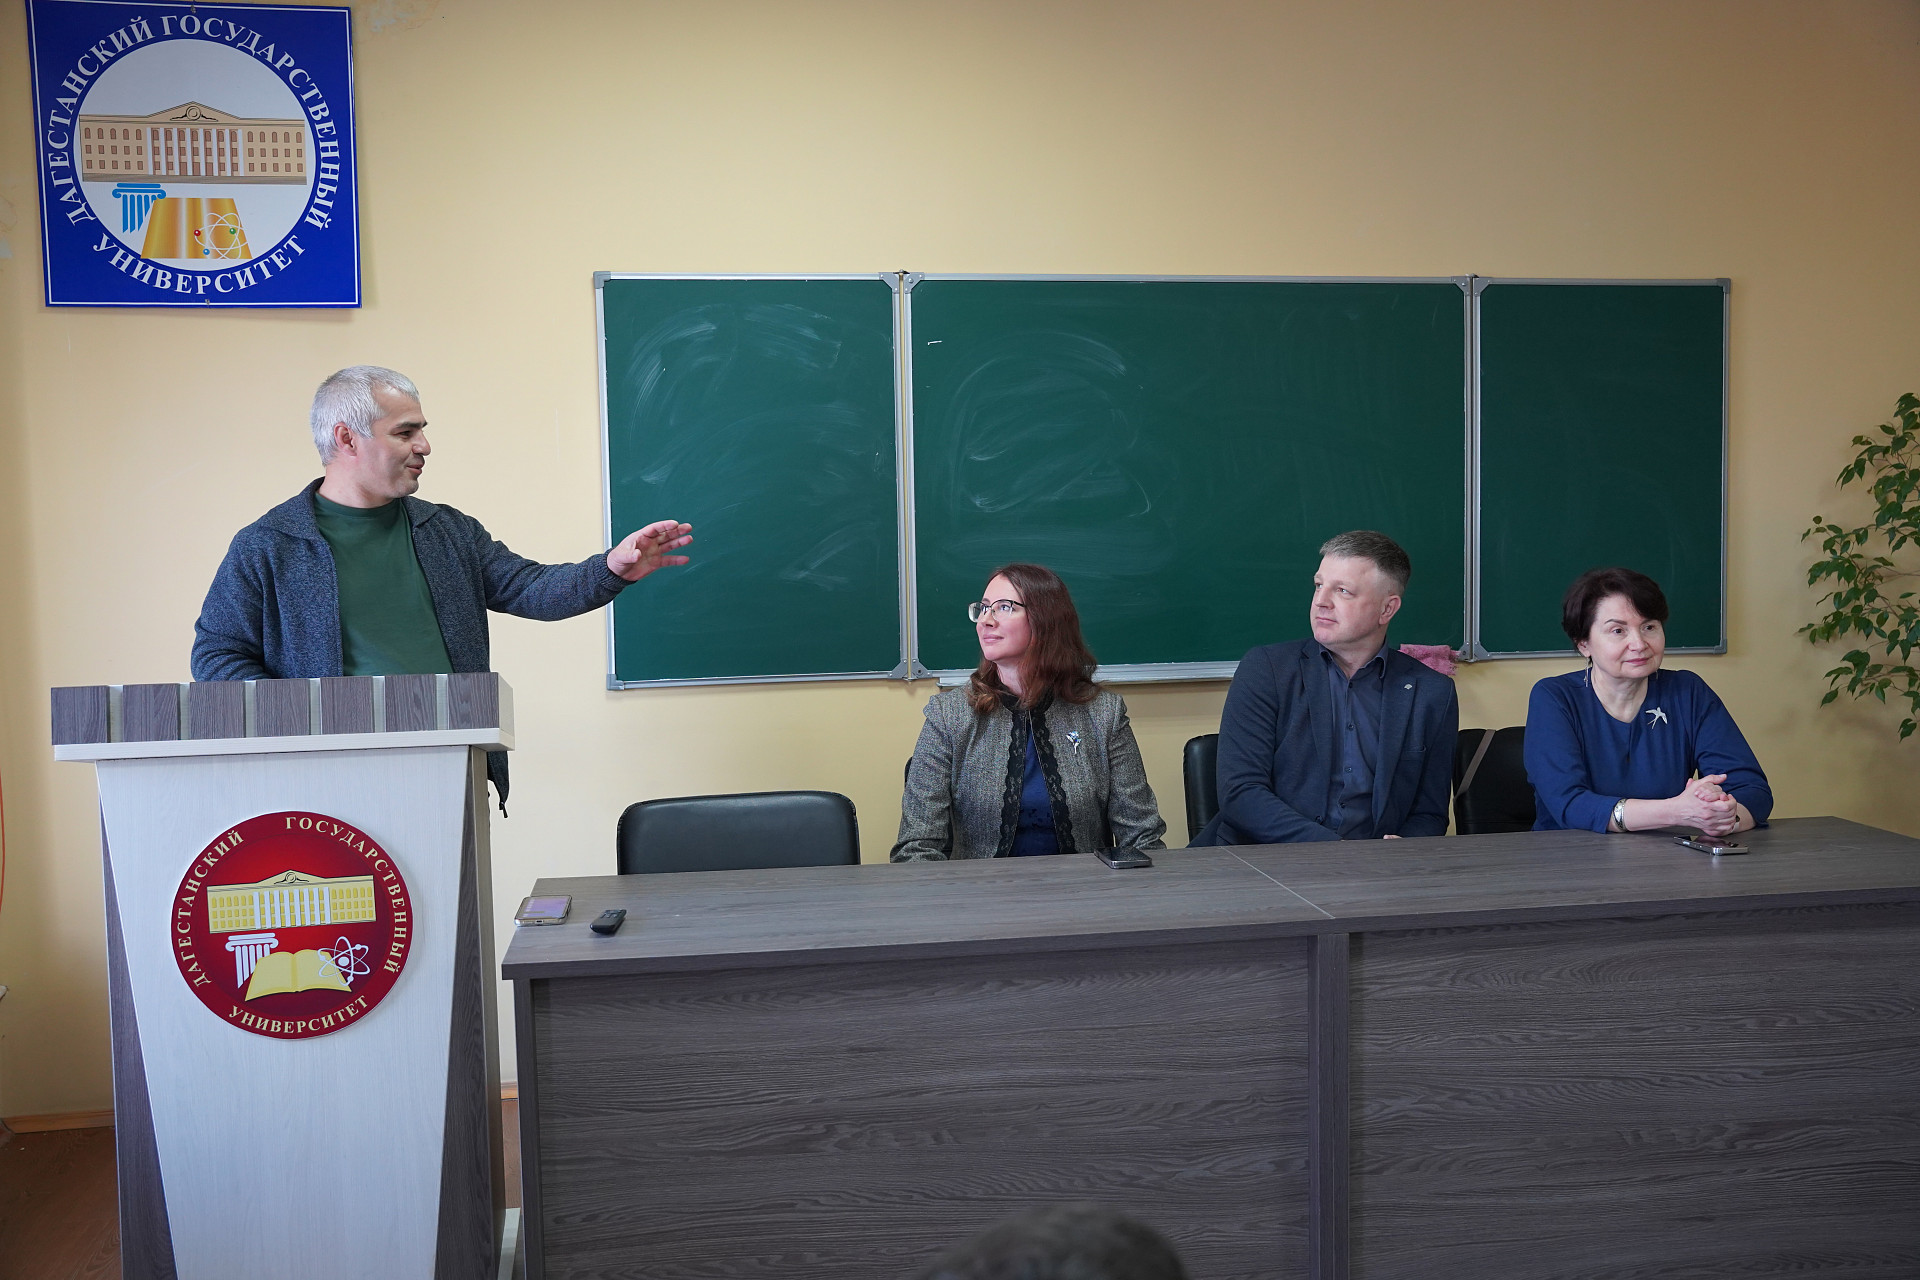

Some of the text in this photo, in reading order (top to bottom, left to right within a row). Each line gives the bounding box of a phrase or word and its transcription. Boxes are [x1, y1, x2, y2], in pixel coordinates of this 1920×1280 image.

[47, 14, 340, 230] ДАГЕСТАНСКИЙ ГОСУДАРСТВЕННЫЙ
[93, 233, 306, 295] УНИВЕРСИТЕТ
[177, 816, 407, 987] ДАГЕСТАНСКИЙ ГОСУДАРСТВЕННЫЙ
[229, 995, 368, 1034] УНИВЕРСИТЕТ
